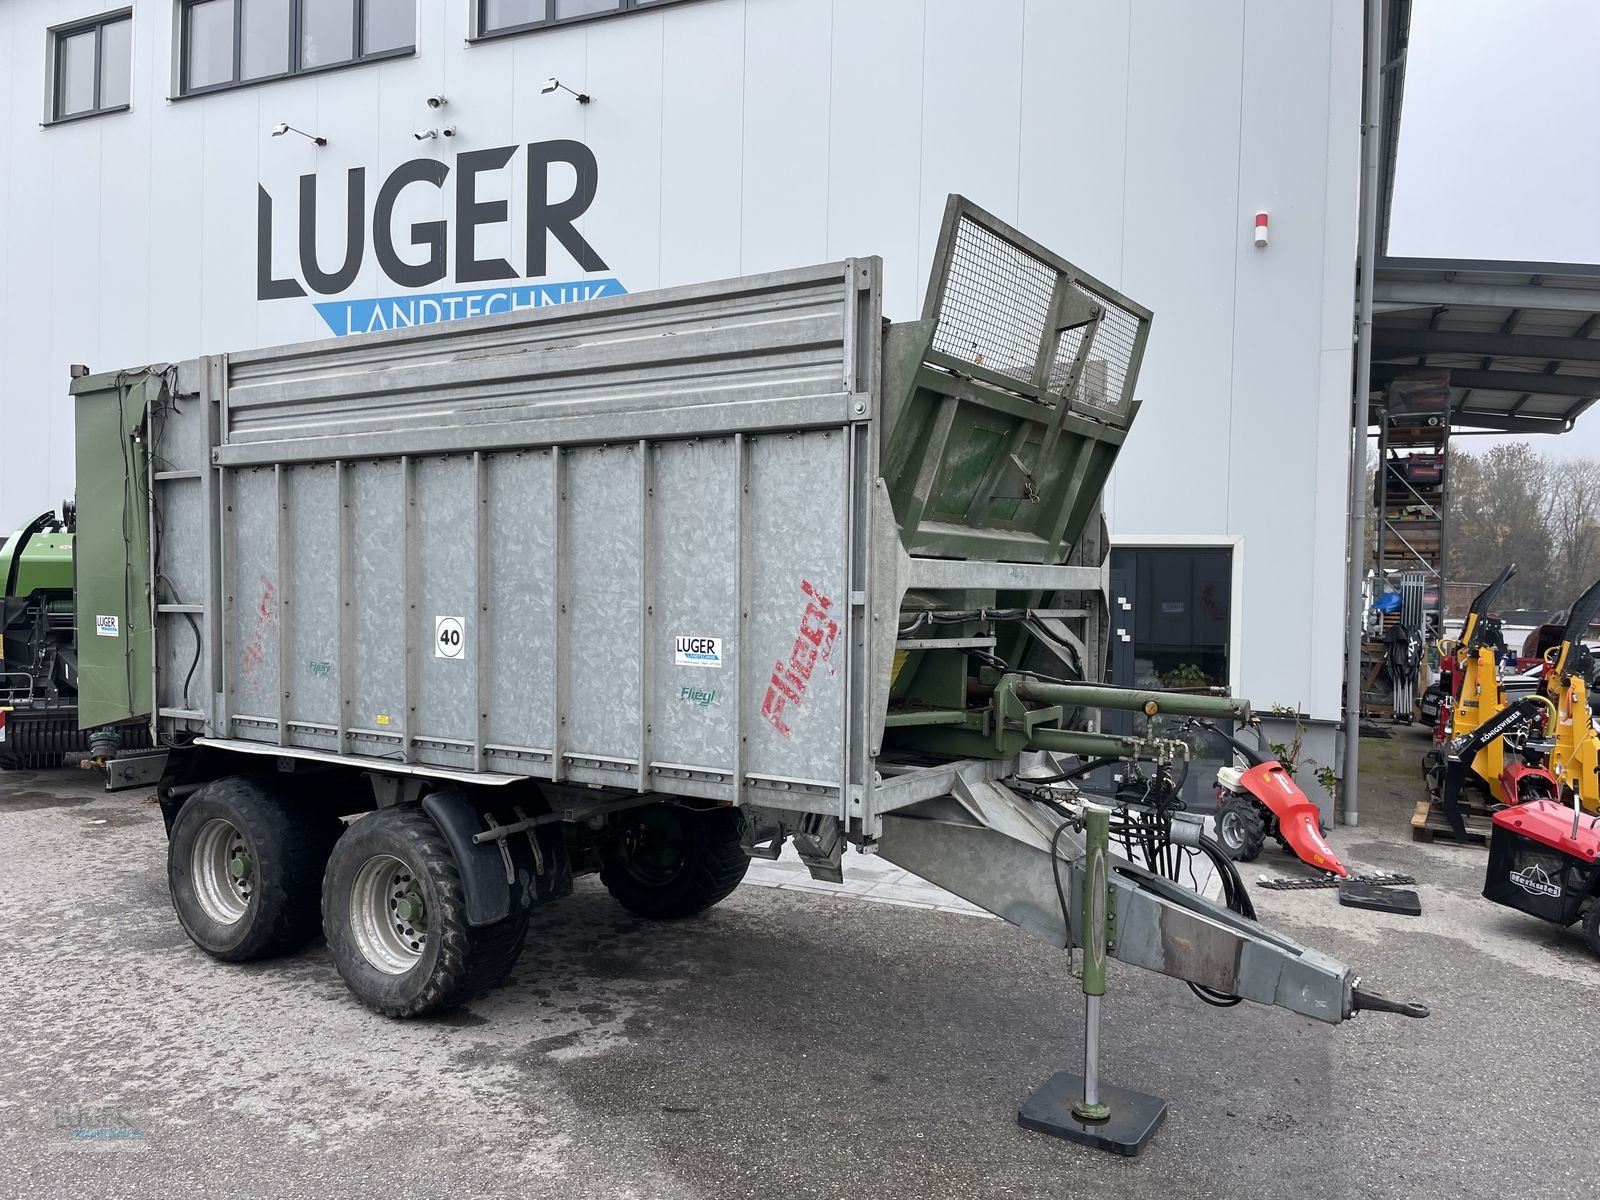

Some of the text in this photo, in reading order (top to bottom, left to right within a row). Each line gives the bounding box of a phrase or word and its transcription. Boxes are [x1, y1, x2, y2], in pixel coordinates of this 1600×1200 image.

[257, 139, 611, 301] LUGER
[97, 617, 116, 627] LUGER
[440, 629, 460, 646] 40
[676, 638, 716, 654] LUGER
[760, 579, 838, 740] Fliegl
[681, 687, 716, 706] Fliegl
[1480, 710, 1522, 743] KÖNIGSWIESER
